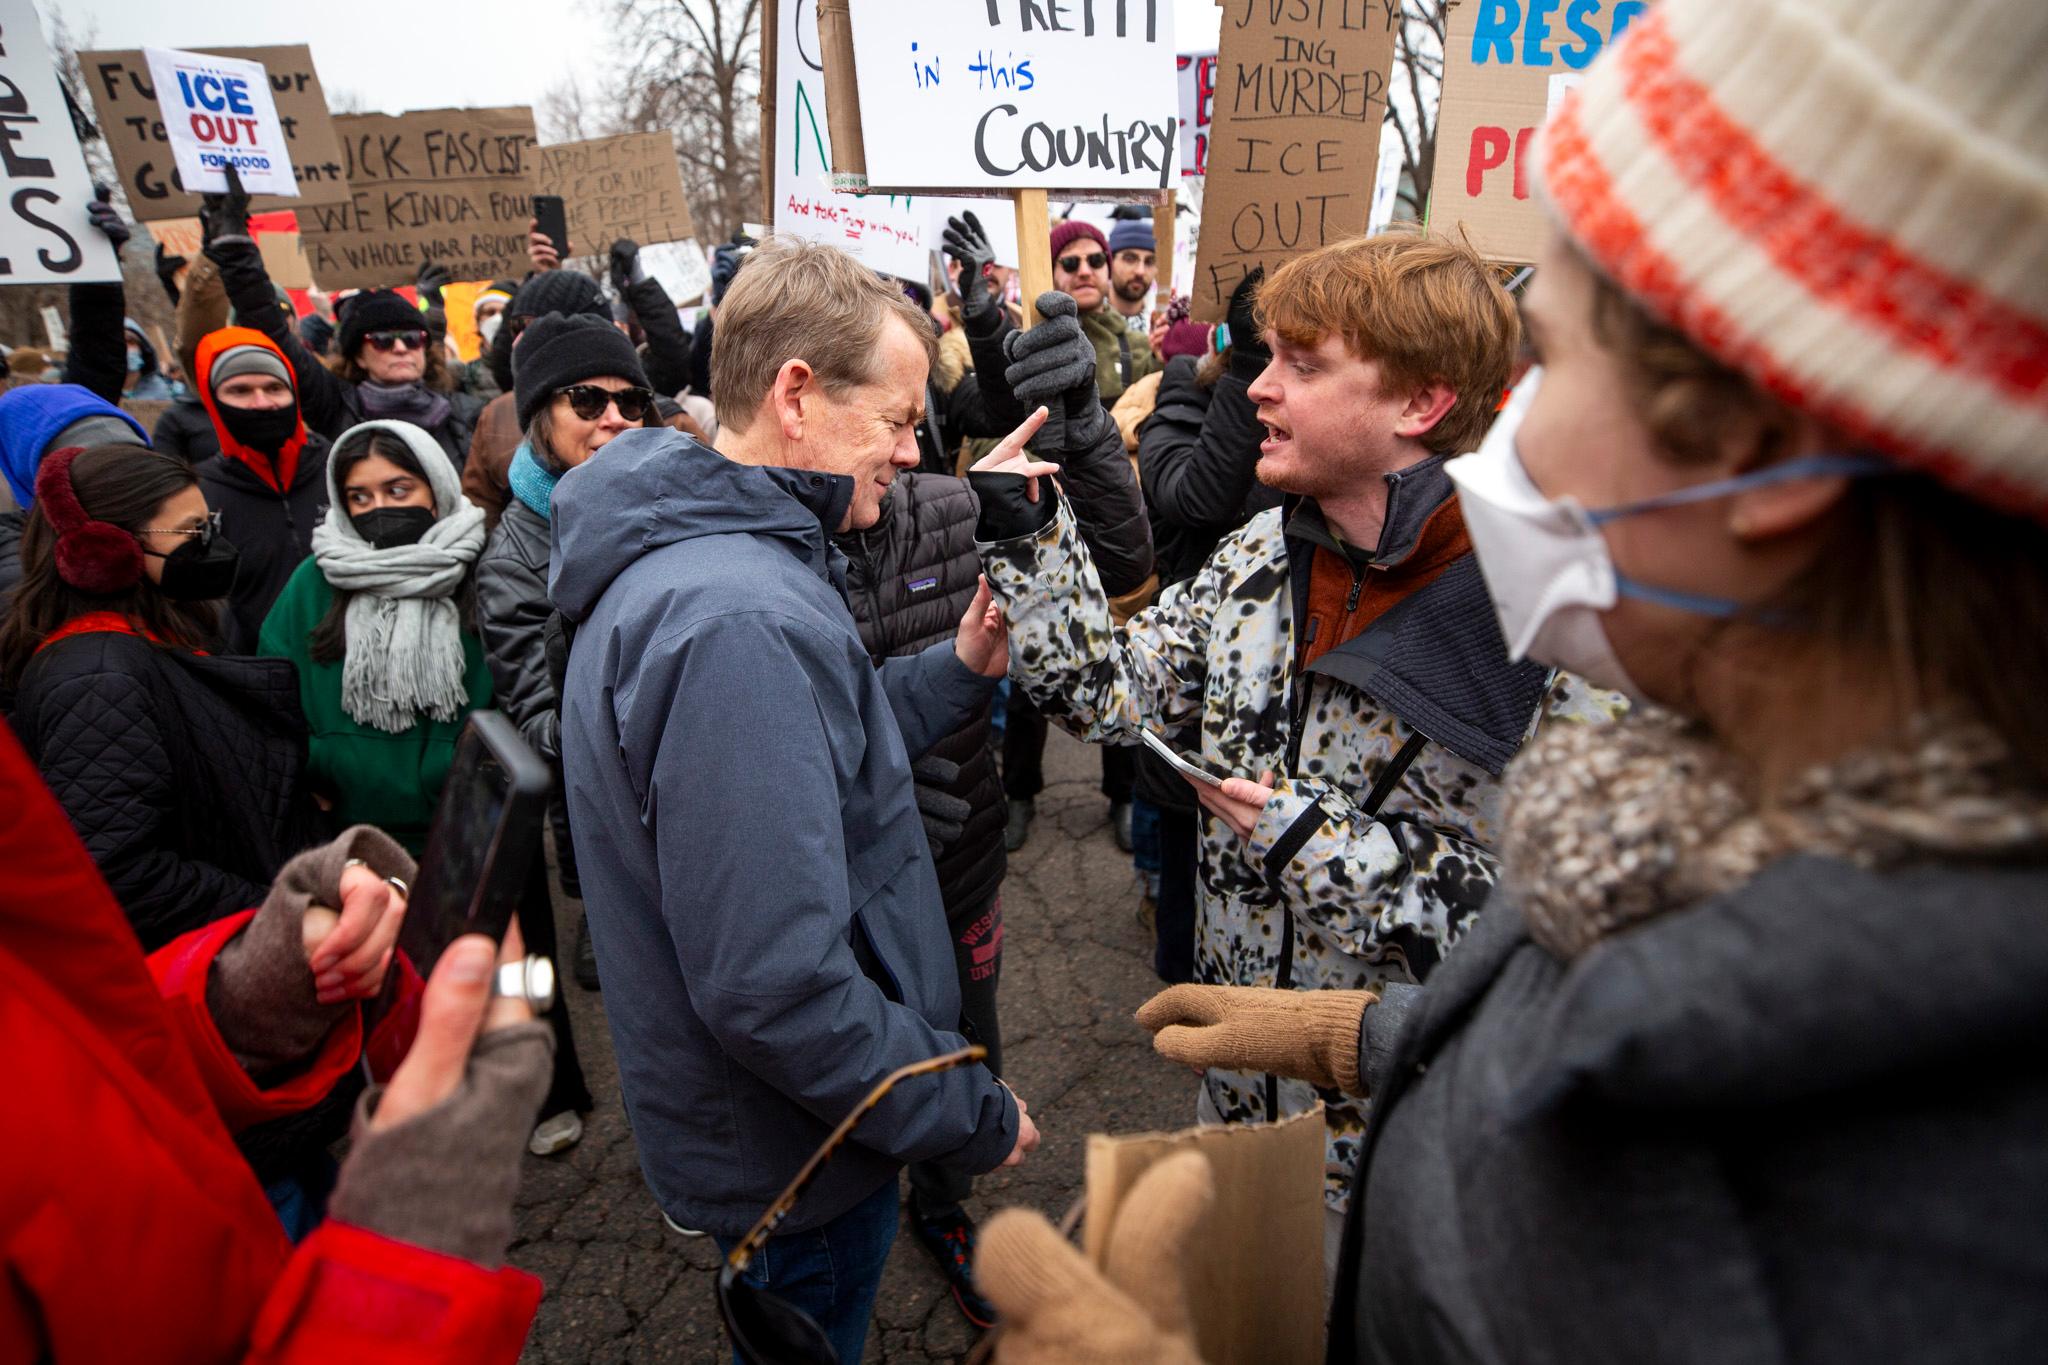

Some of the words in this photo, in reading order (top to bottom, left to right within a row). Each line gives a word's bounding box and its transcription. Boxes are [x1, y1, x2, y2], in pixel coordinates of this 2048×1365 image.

[968, 50, 1035, 91] this
[1274, 36, 1336, 69] ING
[175, 70, 254, 115] ICE
[1234, 63, 1386, 122] MURDER
[190, 113, 258, 146] OUT
[231, 156, 270, 170] GOOD
[1235, 138, 1344, 176] ICE
[313, 192, 372, 232] WE
[384, 191, 481, 230] KINDA
[788, 194, 810, 215] And
[814, 200, 838, 223] take
[840, 208, 865, 230] Trump
[869, 221, 893, 236] with
[1232, 193, 1350, 253] OUT
[316, 242, 340, 272] A
[343, 242, 415, 270] WHOLE
[471, 233, 528, 259] ABOUT
